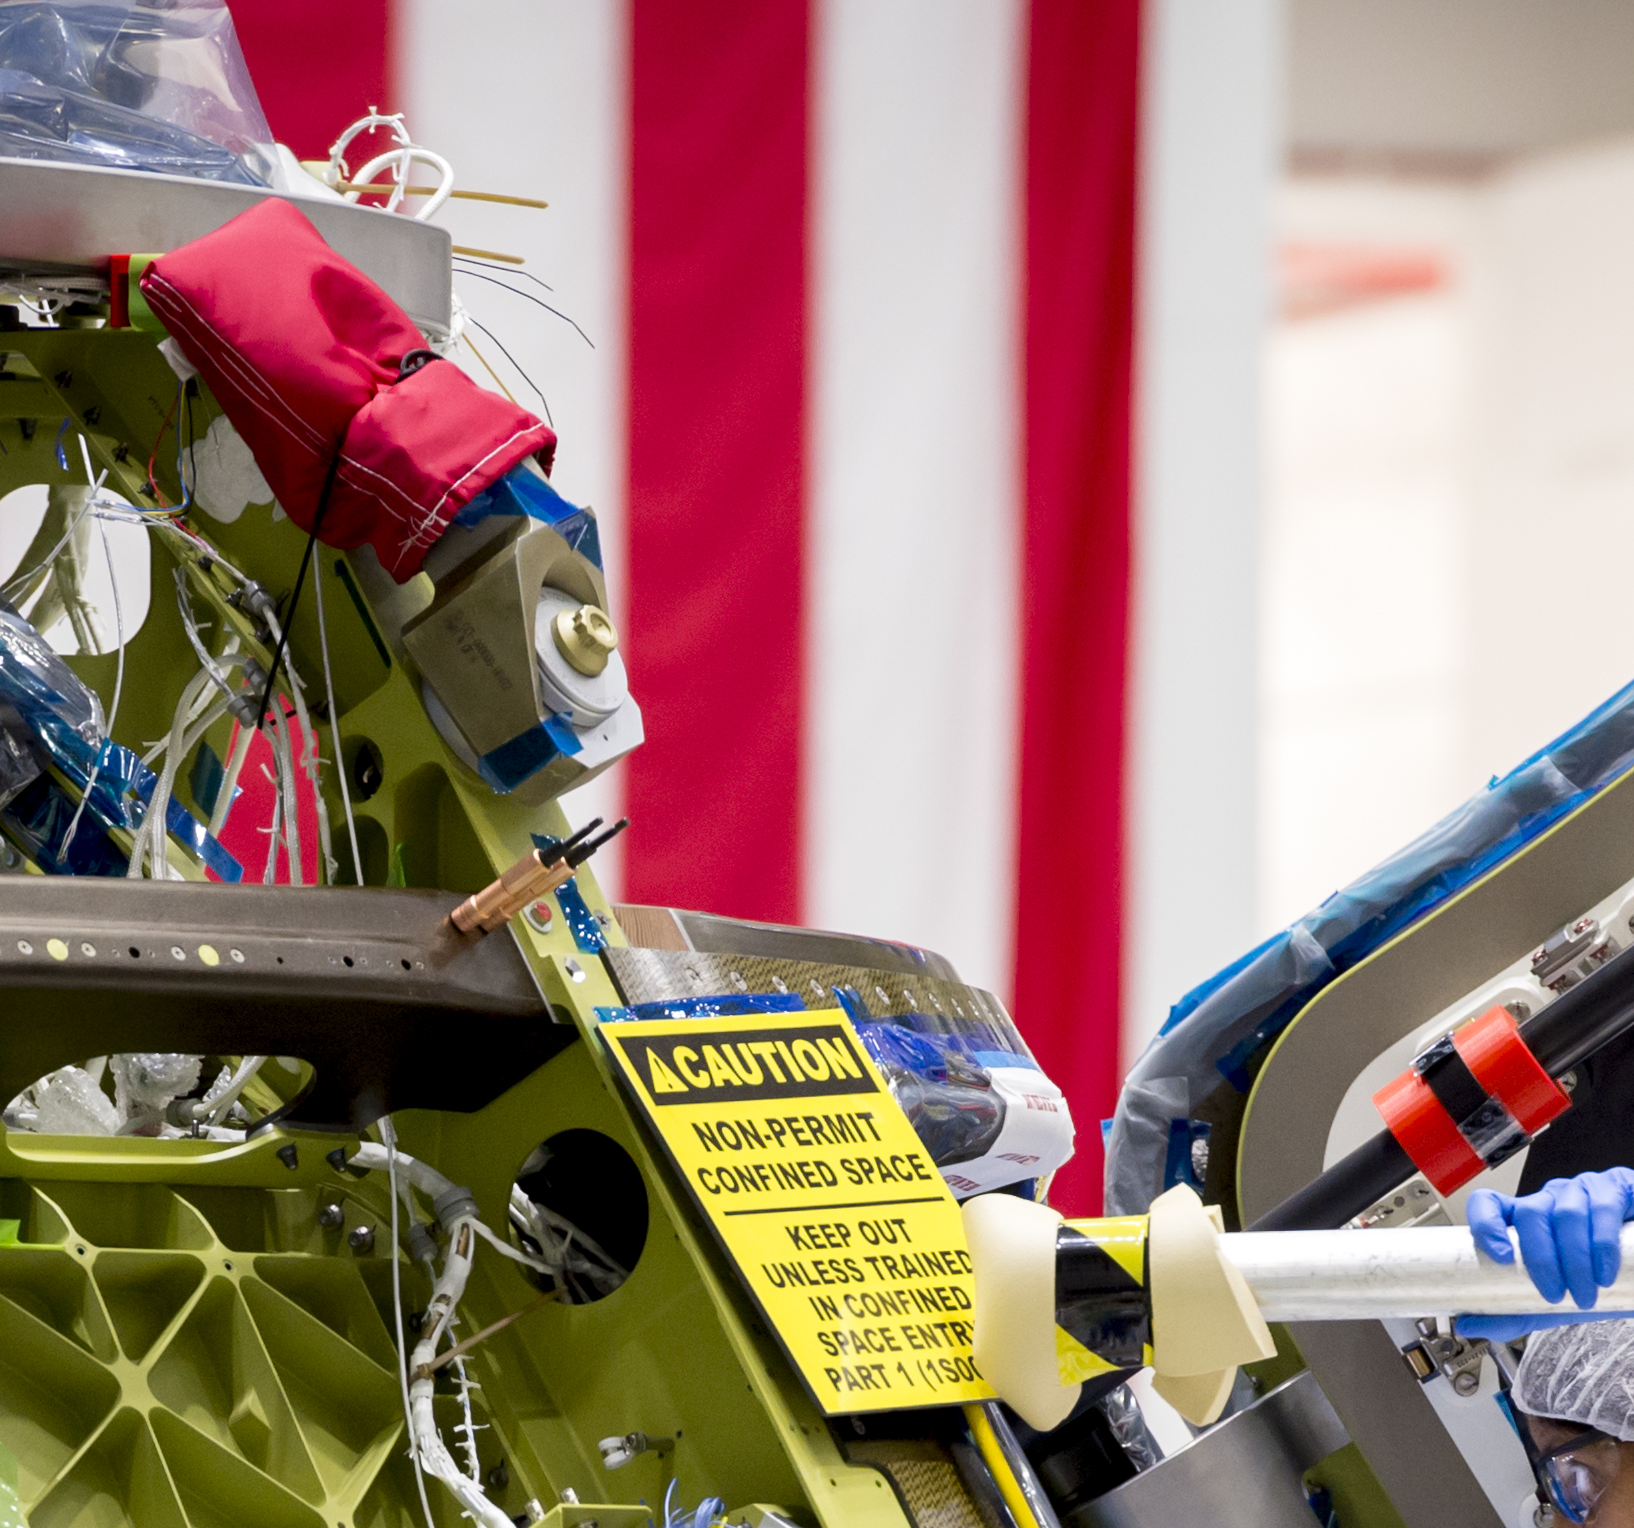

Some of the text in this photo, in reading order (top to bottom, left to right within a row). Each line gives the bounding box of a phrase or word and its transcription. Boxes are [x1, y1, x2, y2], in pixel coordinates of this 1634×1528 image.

[672, 1037, 863, 1089] CAUTION
[691, 1112, 882, 1153] NON-PERMIT
[697, 1160, 839, 1195] CONFINED
[840, 1154, 933, 1186] SPACE
[784, 1218, 913, 1251] KEEP OUT
[762, 1249, 974, 1288] UNLESS TRAINED
[808, 1286, 973, 1321] IN CONFINED
[817, 1326, 903, 1357] SPACE
[823, 1361, 892, 1393] PART
[897, 1361, 915, 1387] 1
